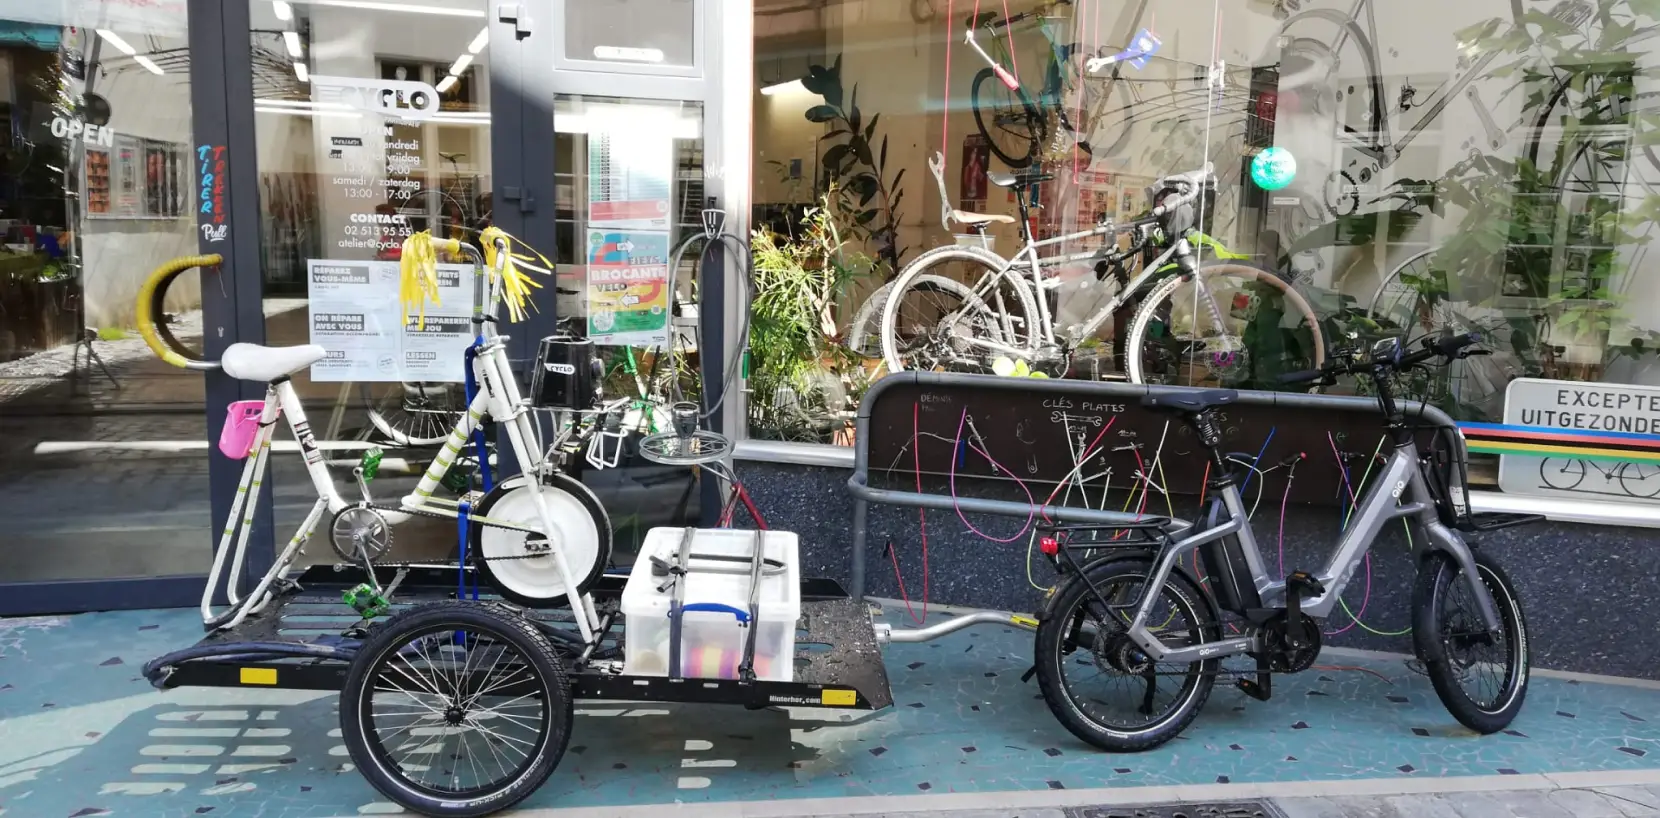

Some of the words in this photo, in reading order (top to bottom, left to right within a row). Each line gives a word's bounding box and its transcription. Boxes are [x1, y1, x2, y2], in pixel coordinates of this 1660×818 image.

[51, 117, 114, 148] OPEN
[388, 152, 420, 165] vrijdag
[332, 175, 366, 185] samedi
[379, 177, 420, 190] zaterdag
[344, 188, 372, 198] 13:00
[383, 189, 411, 200] 17:00
[350, 213, 407, 224] CONTACT
[201, 223, 228, 242] Pull
[344, 225, 358, 236] 02
[361, 226, 380, 236] 513
[382, 226, 396, 237] 95
[398, 227, 412, 237] 55
[338, 236, 403, 251] atelier@cyclo.
[591, 266, 667, 281] BROCANTE
[315, 314, 329, 322] ON
[550, 365, 573, 373] CYCLO
[1042, 396, 1074, 409] CLÉS
[1082, 401, 1126, 413] PLATES
